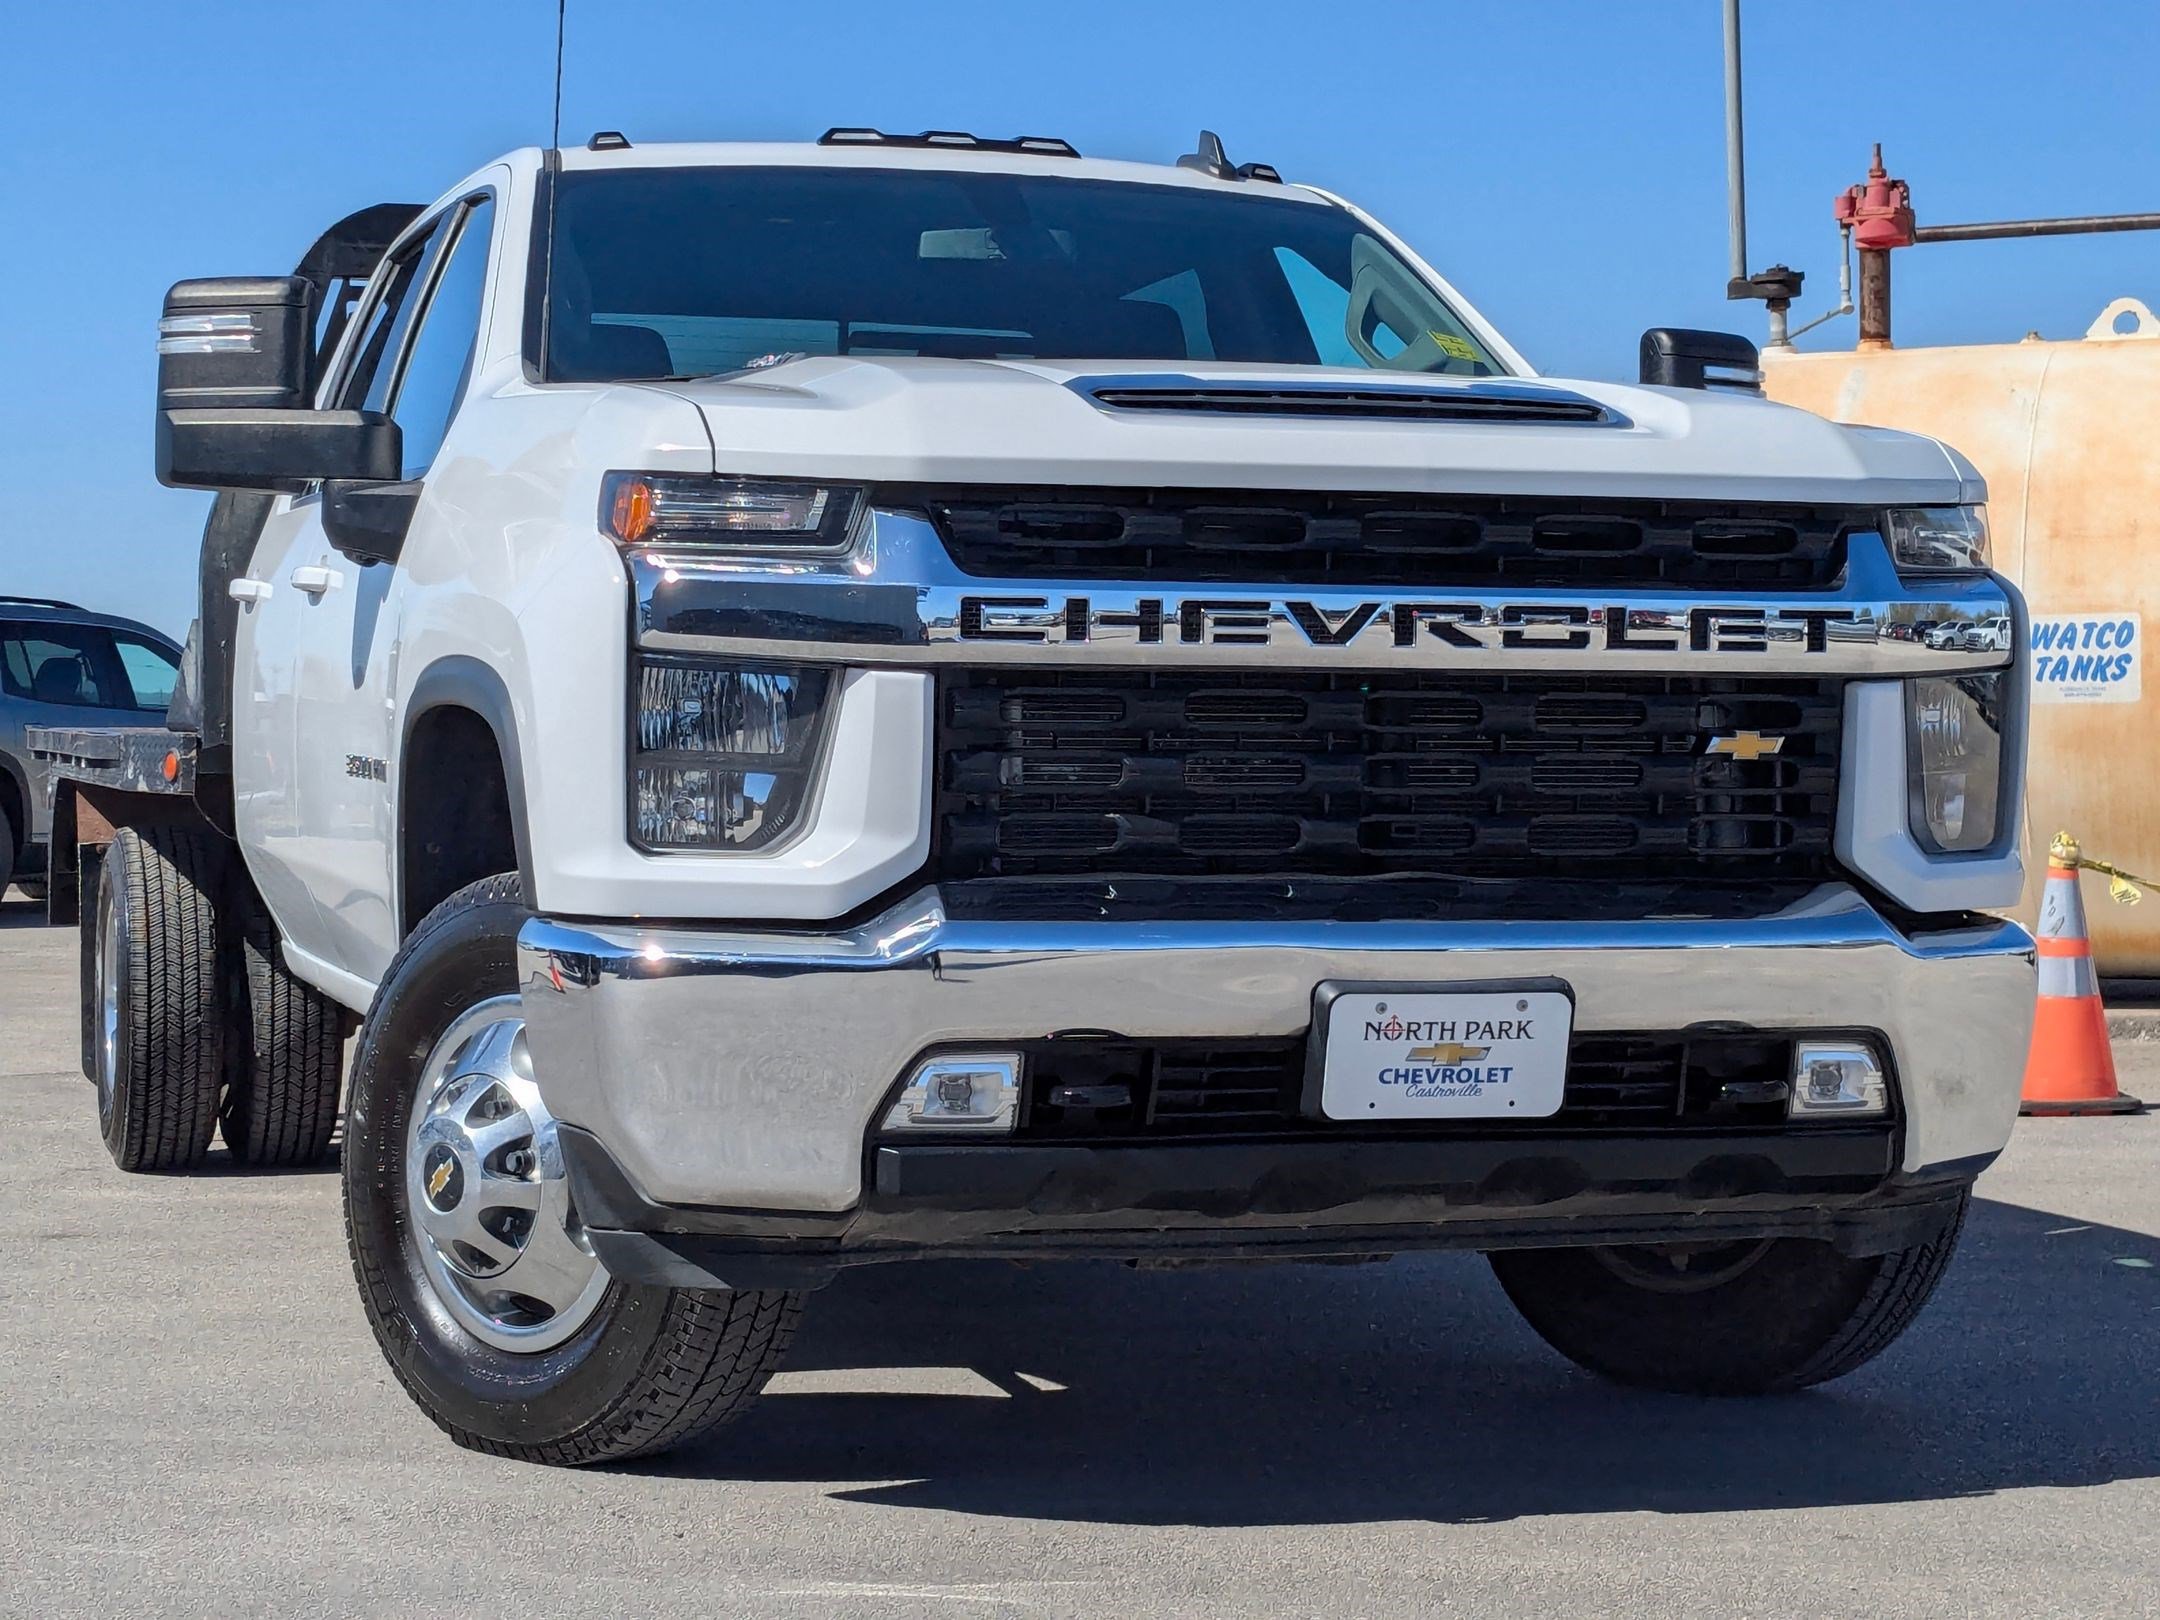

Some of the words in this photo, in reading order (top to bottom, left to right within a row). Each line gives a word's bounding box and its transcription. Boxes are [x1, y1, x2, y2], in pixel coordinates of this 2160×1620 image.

[958, 595, 1856, 653] CHEVROLET
[2031, 620, 2135, 651] WATCO
[2035, 653, 2132, 682] TANKS
[1363, 1020, 1456, 1041] NORTH
[1464, 1019, 1535, 1040] PARK
[1378, 1067, 1513, 1085] CHEVROLET
[1405, 1083, 1483, 1098] Castroville
